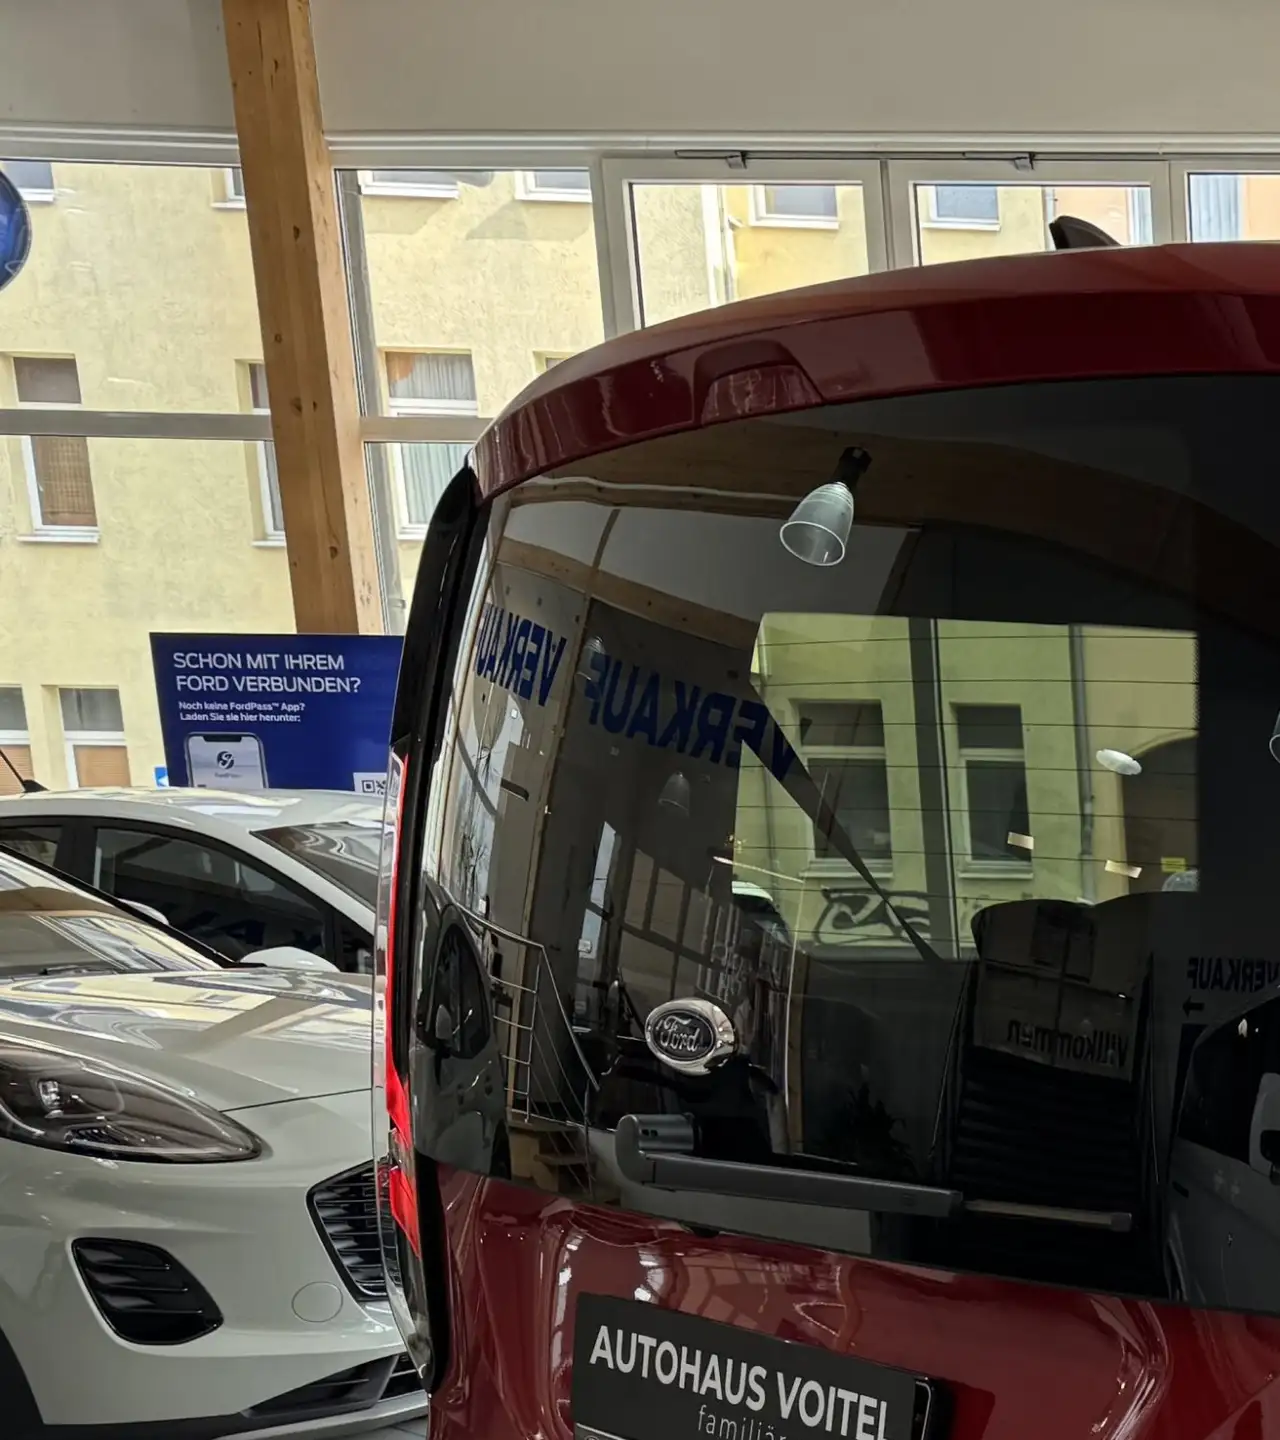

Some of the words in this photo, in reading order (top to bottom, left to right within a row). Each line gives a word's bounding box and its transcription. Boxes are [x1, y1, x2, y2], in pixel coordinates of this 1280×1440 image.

[173, 652, 243, 669] SCHON
[246, 653, 280, 670] MIT
[284, 654, 345, 671] IHREM
[176, 675, 230, 692] FORD
[232, 676, 361, 693] VERBUNDEN?
[178, 701, 203, 711] Noch
[204, 702, 229, 711] keine
[281, 703, 306, 713] App?
[180, 712, 209, 722] Laden
[210, 713, 224, 722] Sie
[226, 713, 239, 722] sie
[240, 713, 257, 722] hier
[259, 714, 301, 723] herunter:
[655, 1015, 701, 1053] Ford
[589, 1325, 768, 1411] AUTOHAUS
